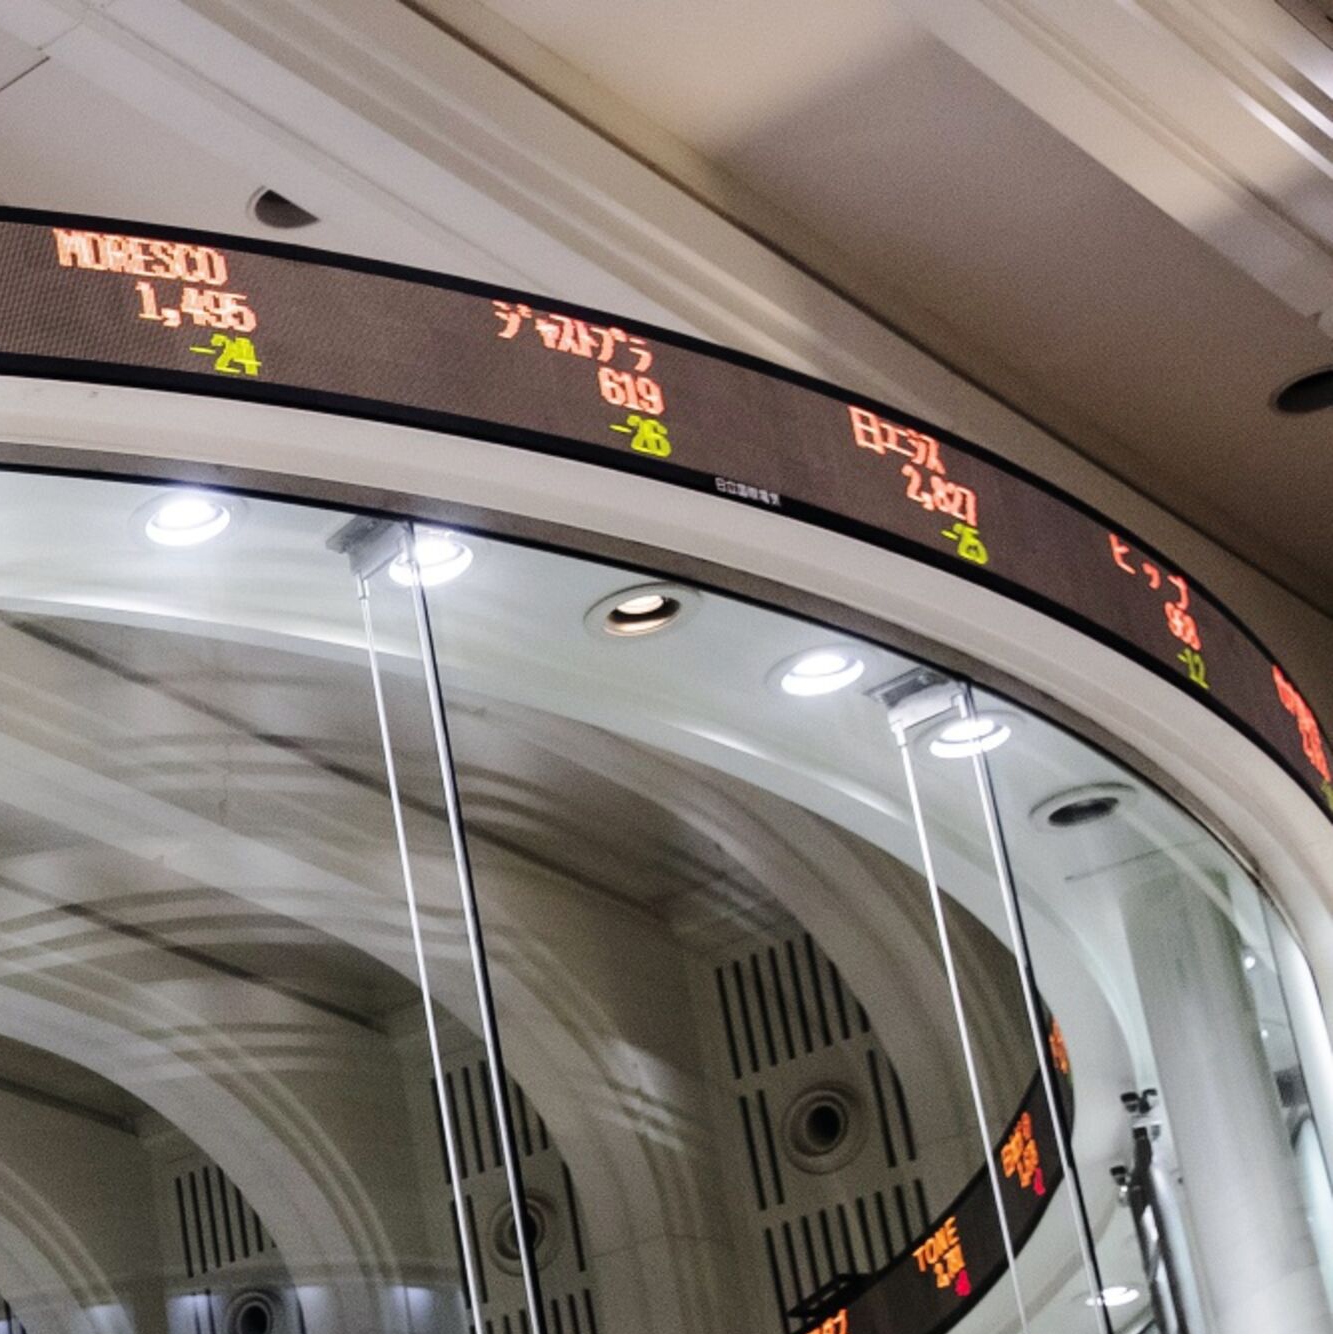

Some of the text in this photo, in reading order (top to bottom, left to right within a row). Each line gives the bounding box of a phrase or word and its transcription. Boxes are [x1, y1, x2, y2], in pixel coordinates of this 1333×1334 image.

[53, 227, 228, 286] MORESCO
[189, 333, 261, 376] -24
[598, 367, 665, 415] 619
